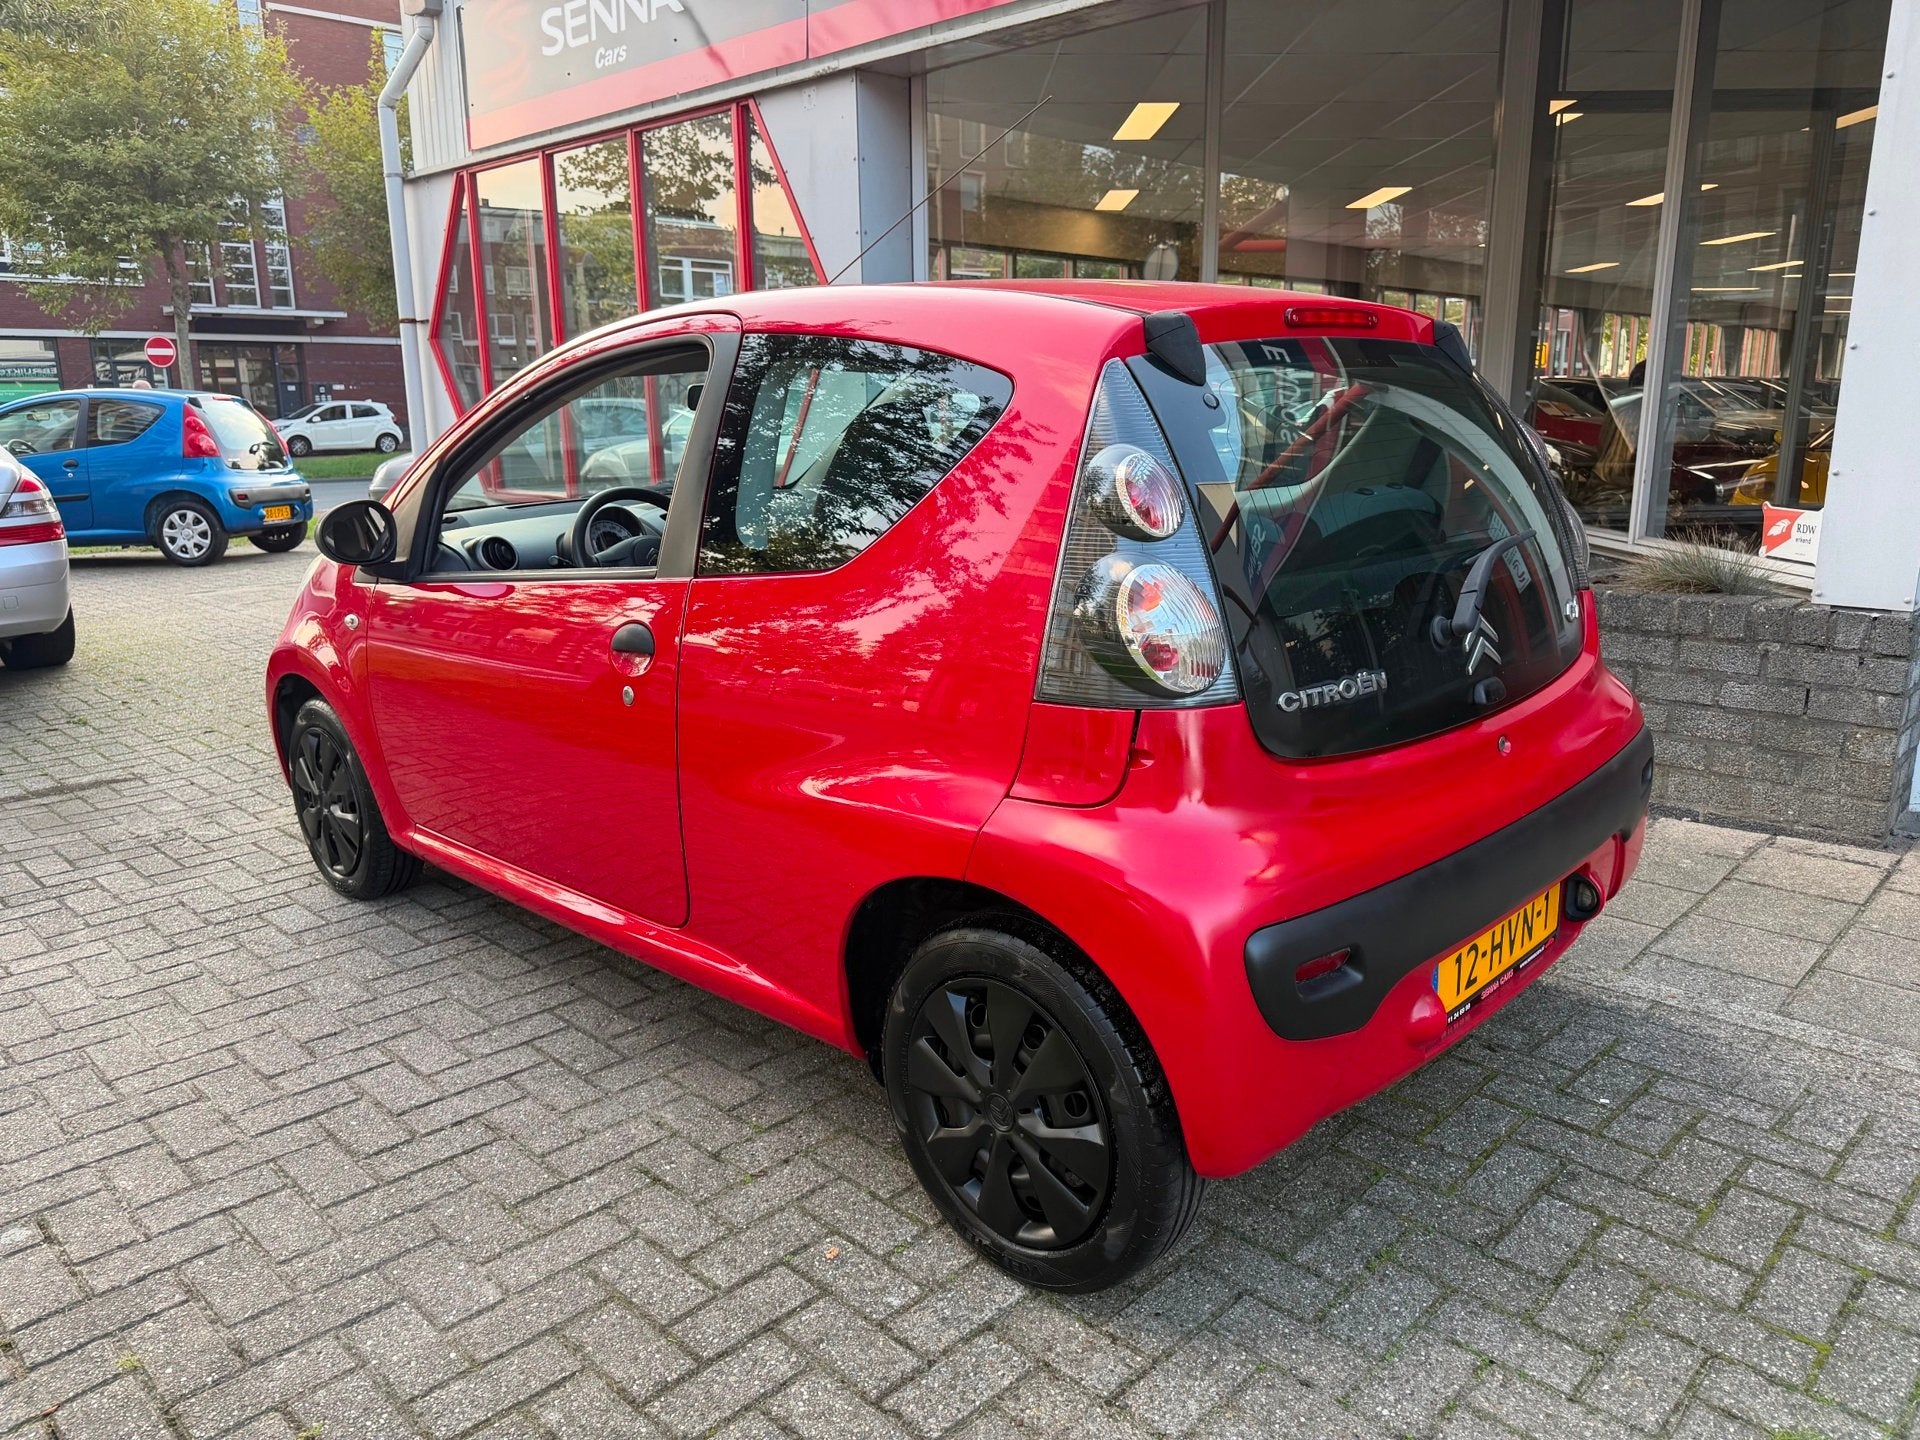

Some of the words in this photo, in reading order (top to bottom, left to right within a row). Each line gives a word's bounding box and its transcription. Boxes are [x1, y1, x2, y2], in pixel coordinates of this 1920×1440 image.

[595, 44, 628, 69] Cars
[1795, 537, 1812, 545] erkend
[1796, 523, 1817, 535] RDW
[1276, 670, 1389, 713] CITROËN
[1455, 890, 1551, 997] 12-HVN-1
